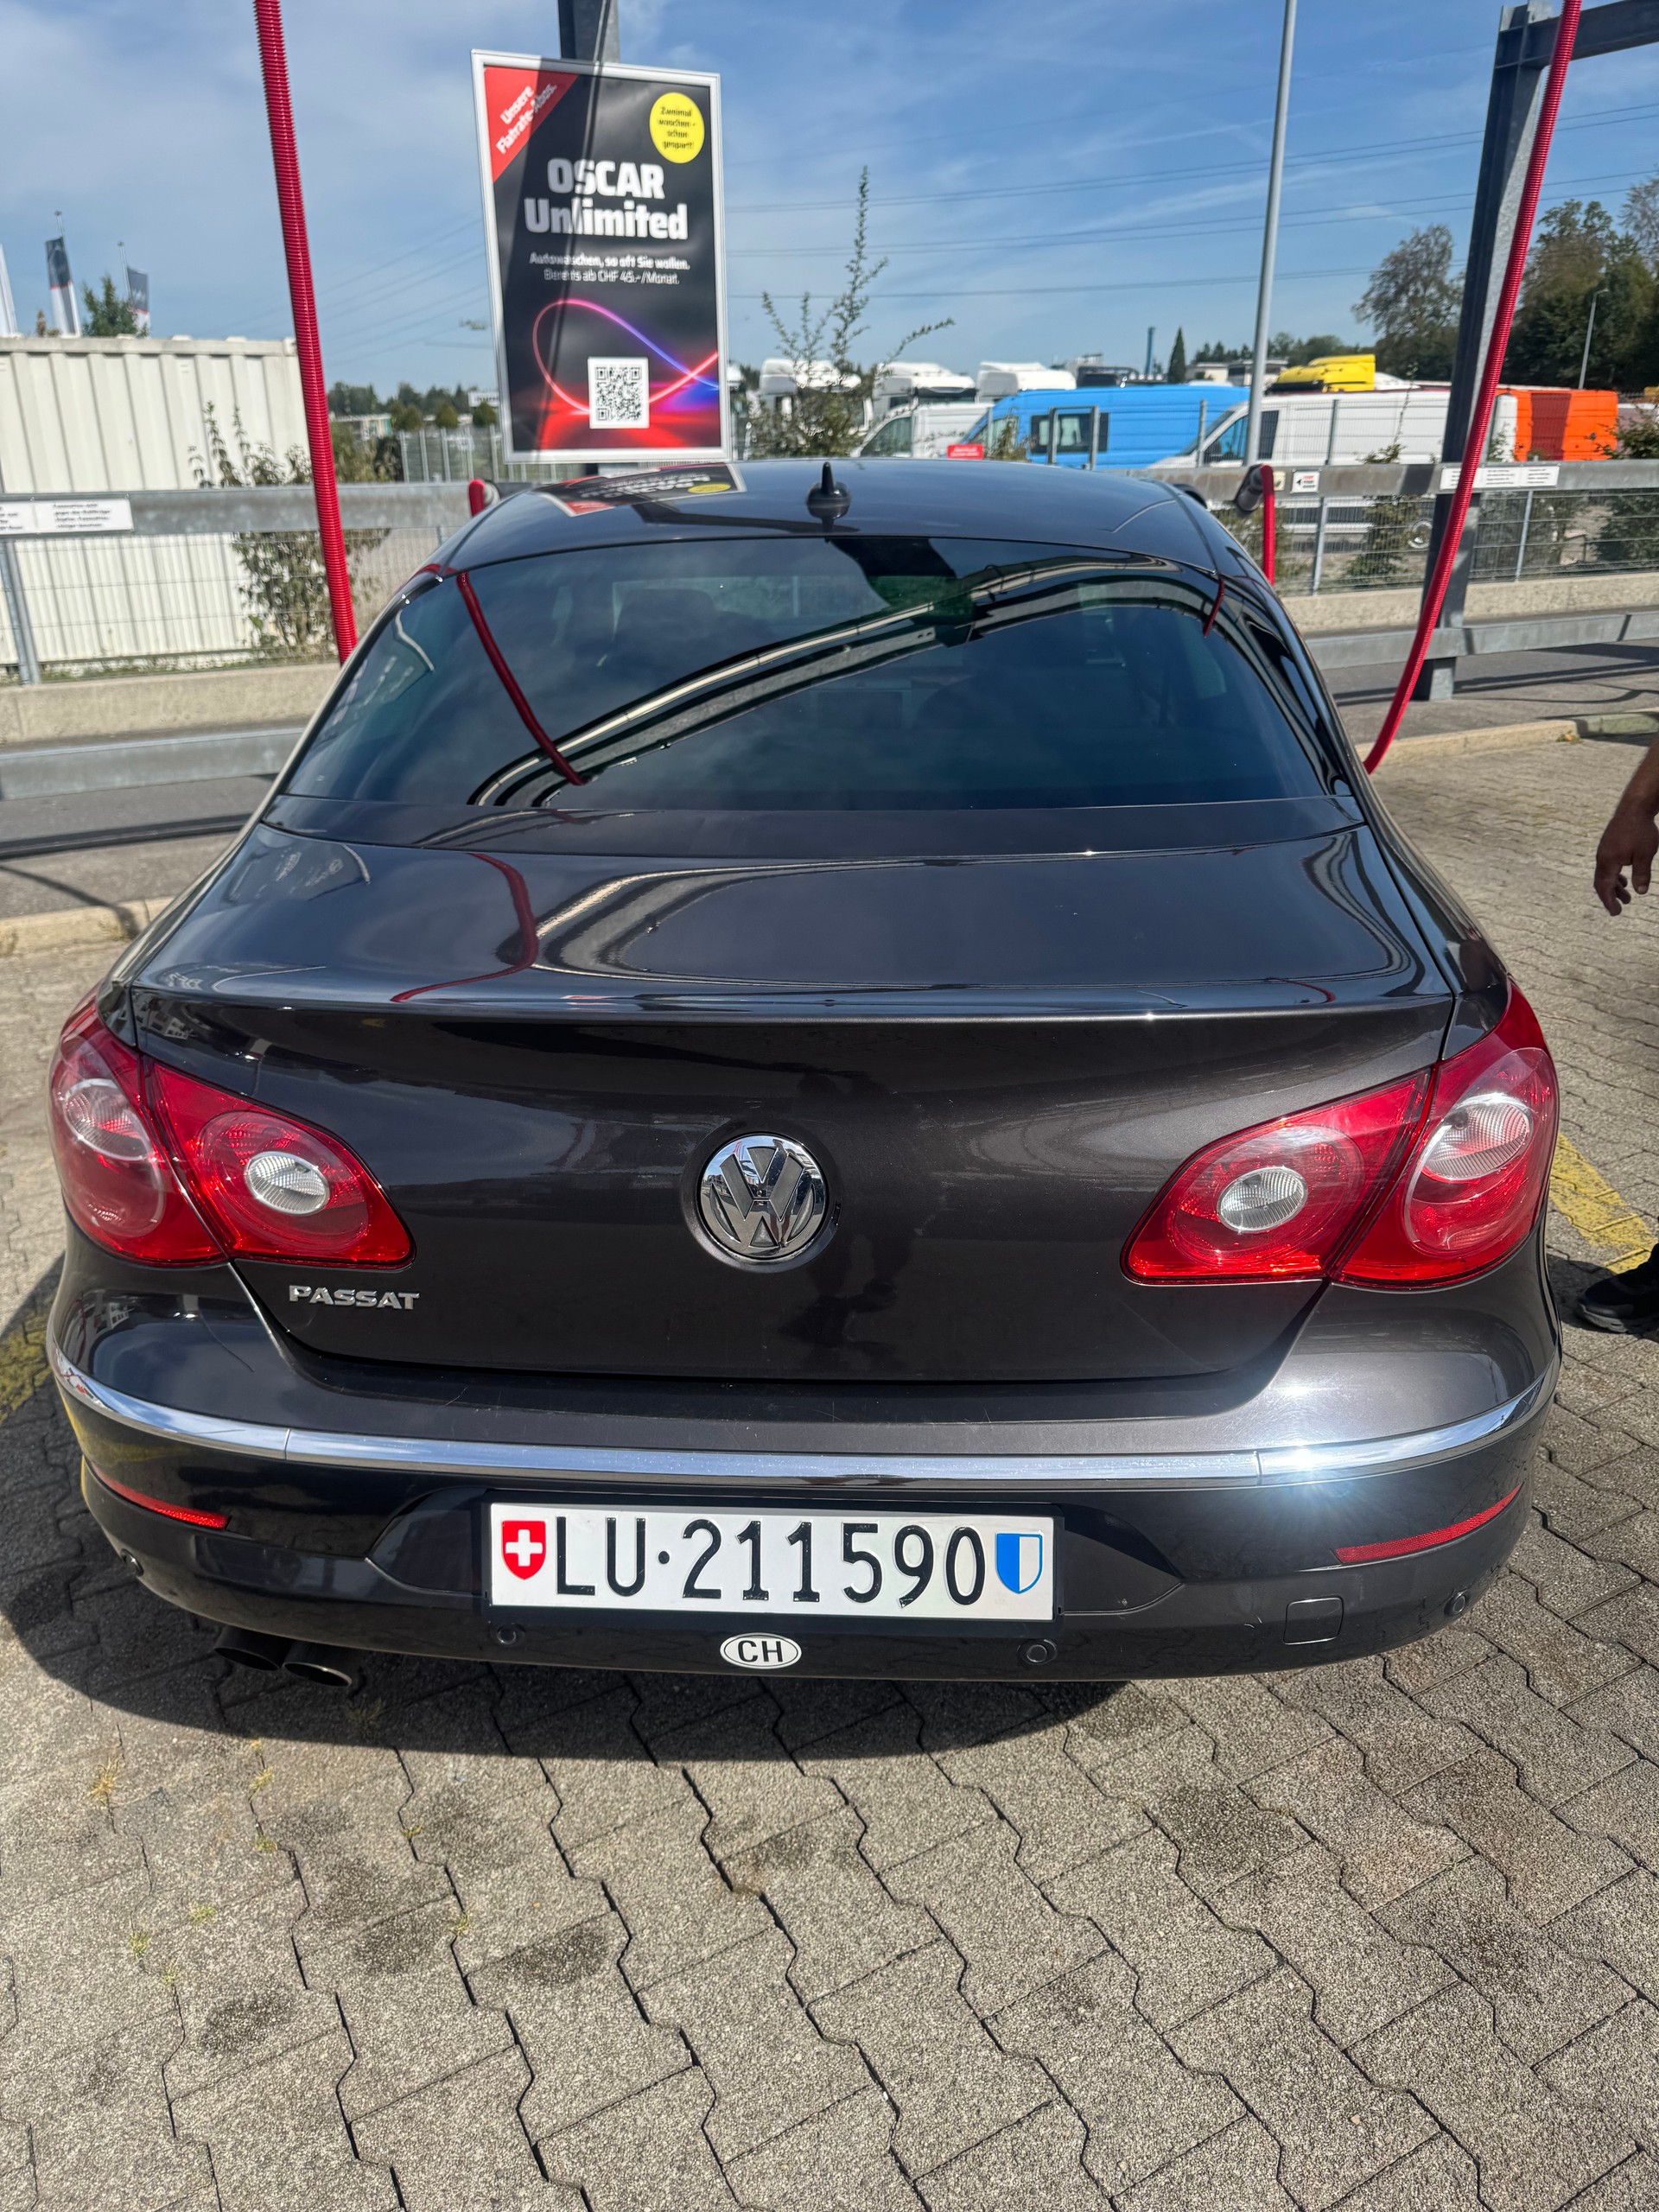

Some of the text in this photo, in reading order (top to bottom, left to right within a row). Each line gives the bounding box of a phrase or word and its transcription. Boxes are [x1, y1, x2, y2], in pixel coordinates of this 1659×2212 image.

[499, 86, 534, 124] Unsere
[547, 158, 665, 199] OSCAR
[524, 198, 688, 240] Unlimited
[529, 251, 690, 270] Autowaschen, so oft Sie wollen.
[543, 268, 582, 282] Bereits
[582, 269, 597, 282] ab
[598, 269, 619, 283] CHF
[289, 1285, 420, 1310] PASSAT
[737, 1640, 784, 1662] CH
